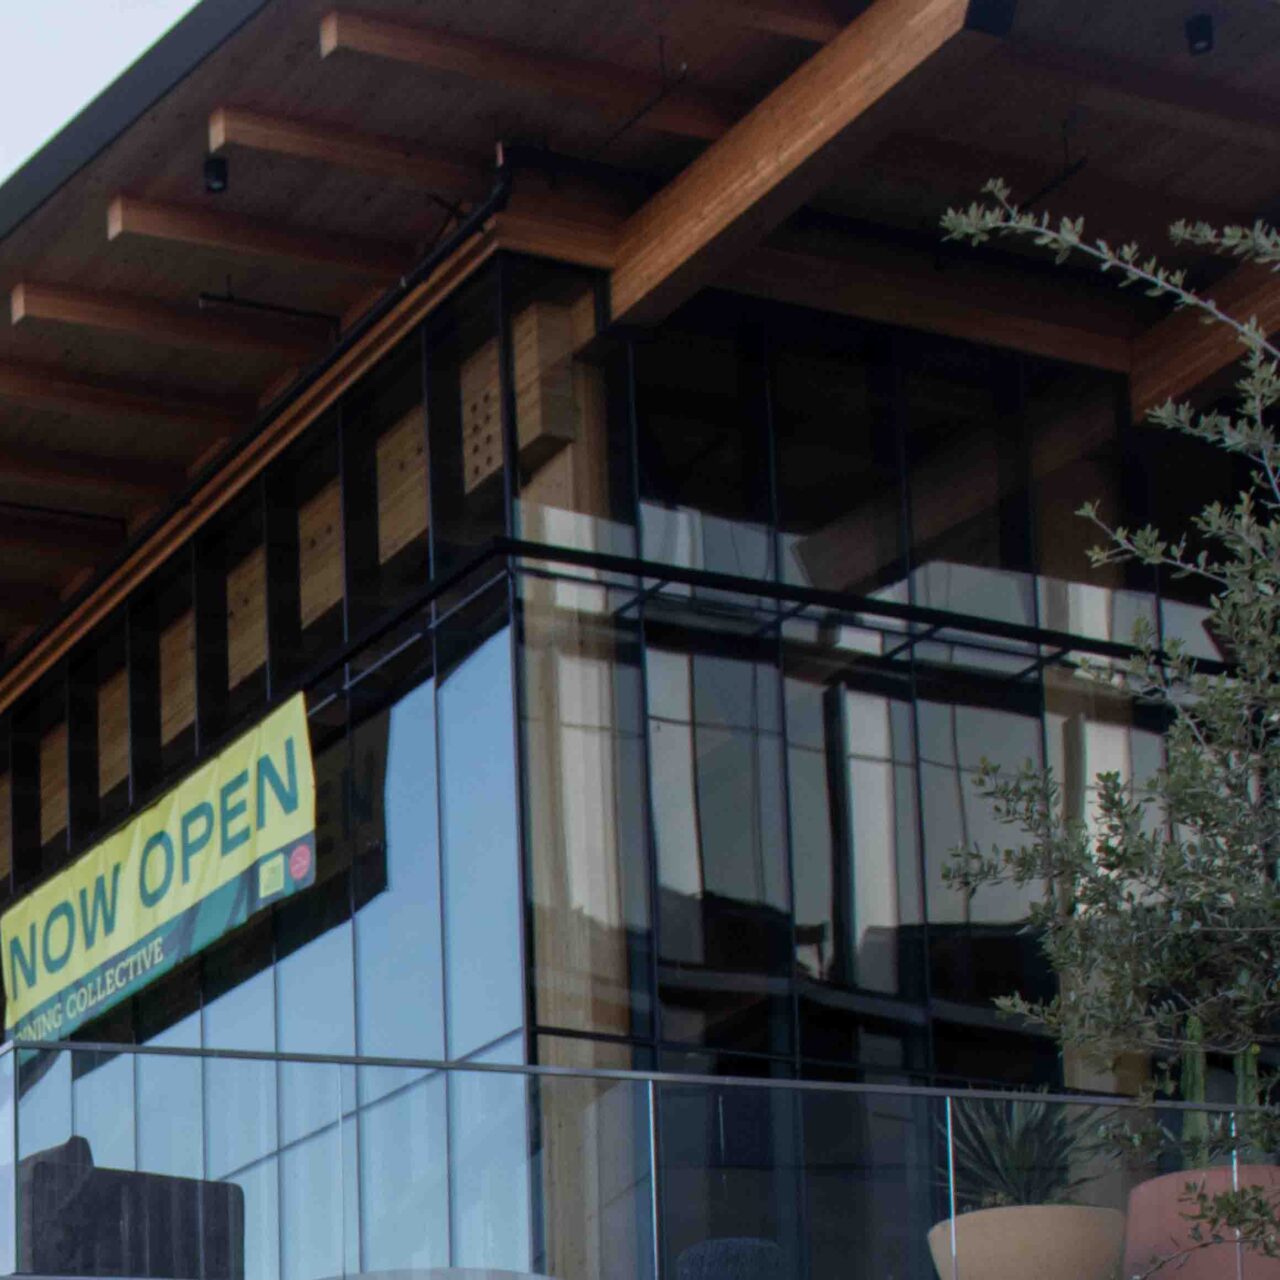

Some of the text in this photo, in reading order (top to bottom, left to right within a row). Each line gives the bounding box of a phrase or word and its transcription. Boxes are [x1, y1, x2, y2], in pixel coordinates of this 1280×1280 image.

[9, 737, 299, 1001] NOW OPEN
[17, 936, 163, 1040] NING COLLECTIVE
